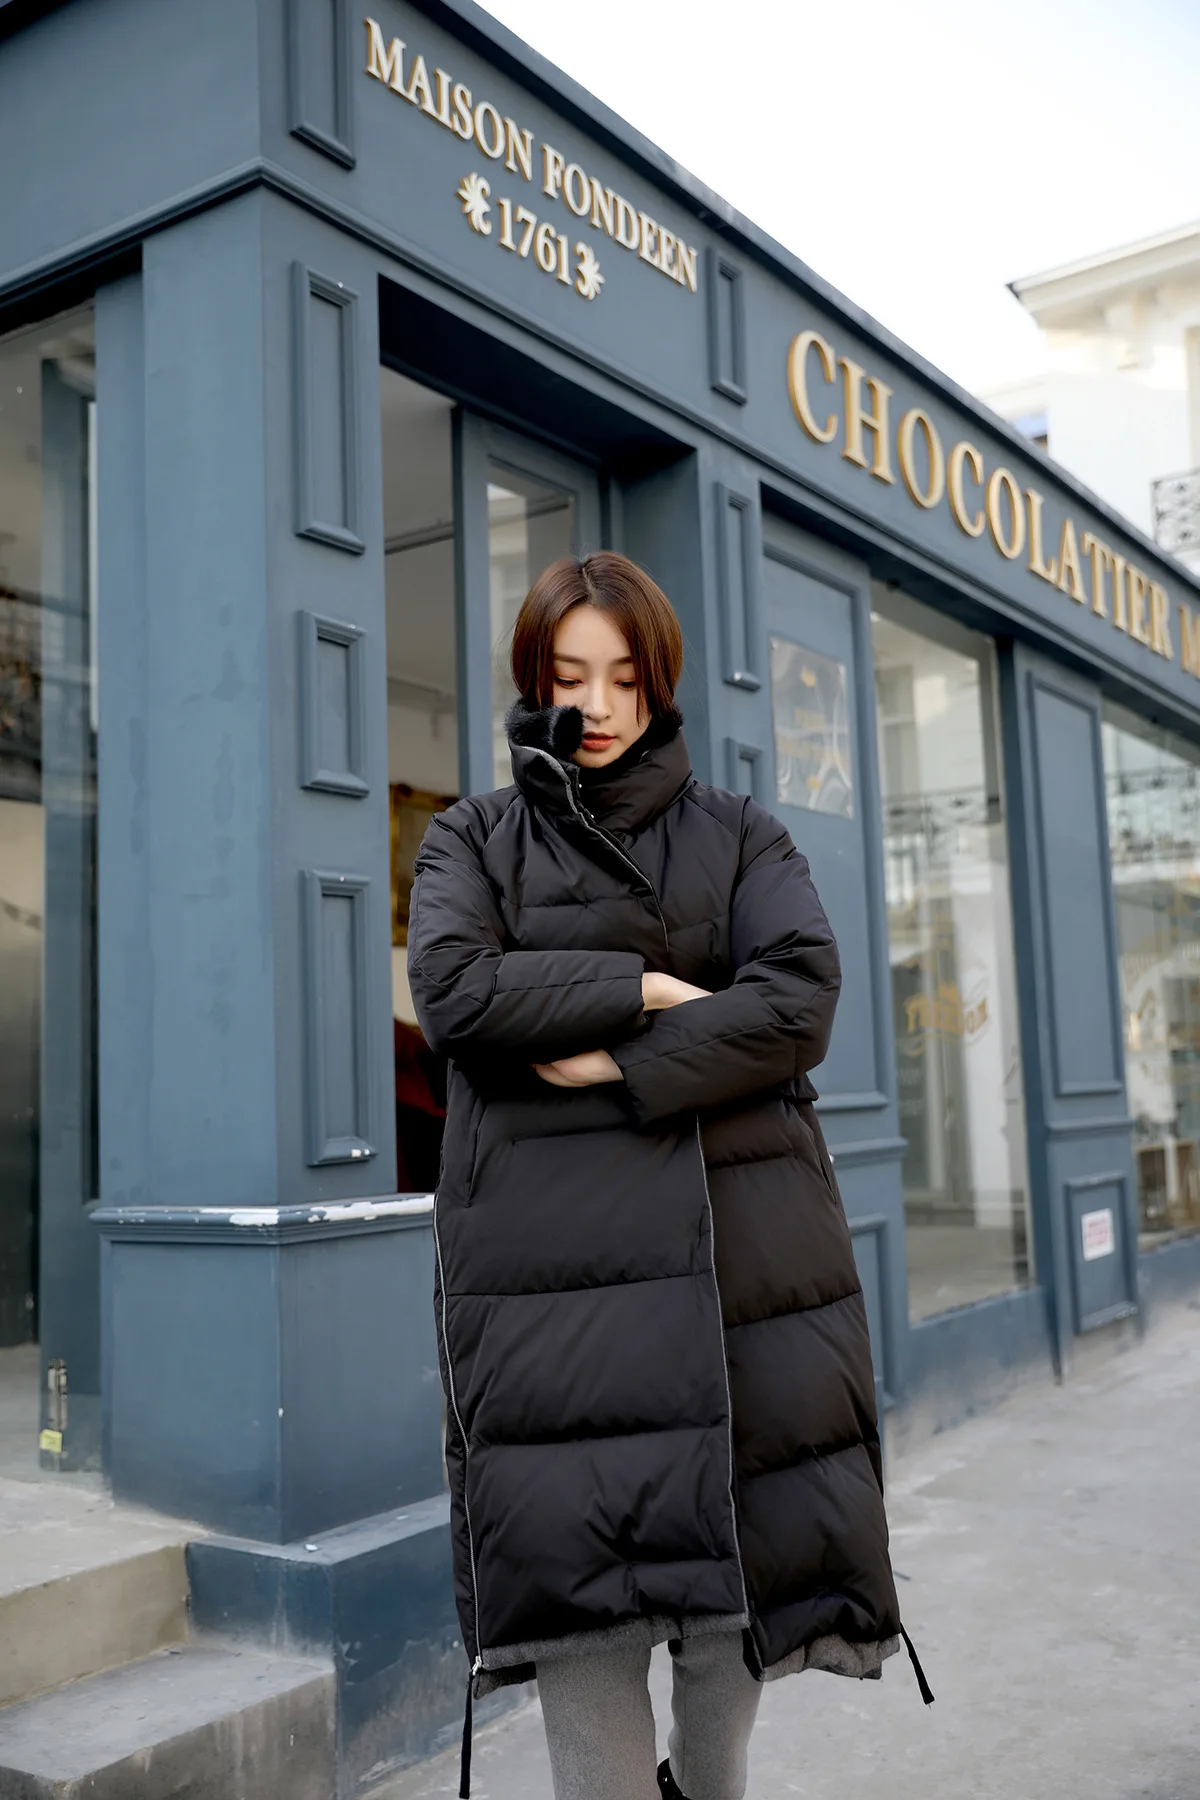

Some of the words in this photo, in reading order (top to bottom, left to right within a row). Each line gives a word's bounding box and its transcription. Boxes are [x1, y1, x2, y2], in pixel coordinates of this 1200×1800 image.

[364, 16, 535, 182] MAISON
[540, 143, 698, 293] FONDEEN
[498, 197, 573, 287] 1761
[787, 329, 1174, 661] CHOCOLATIER
